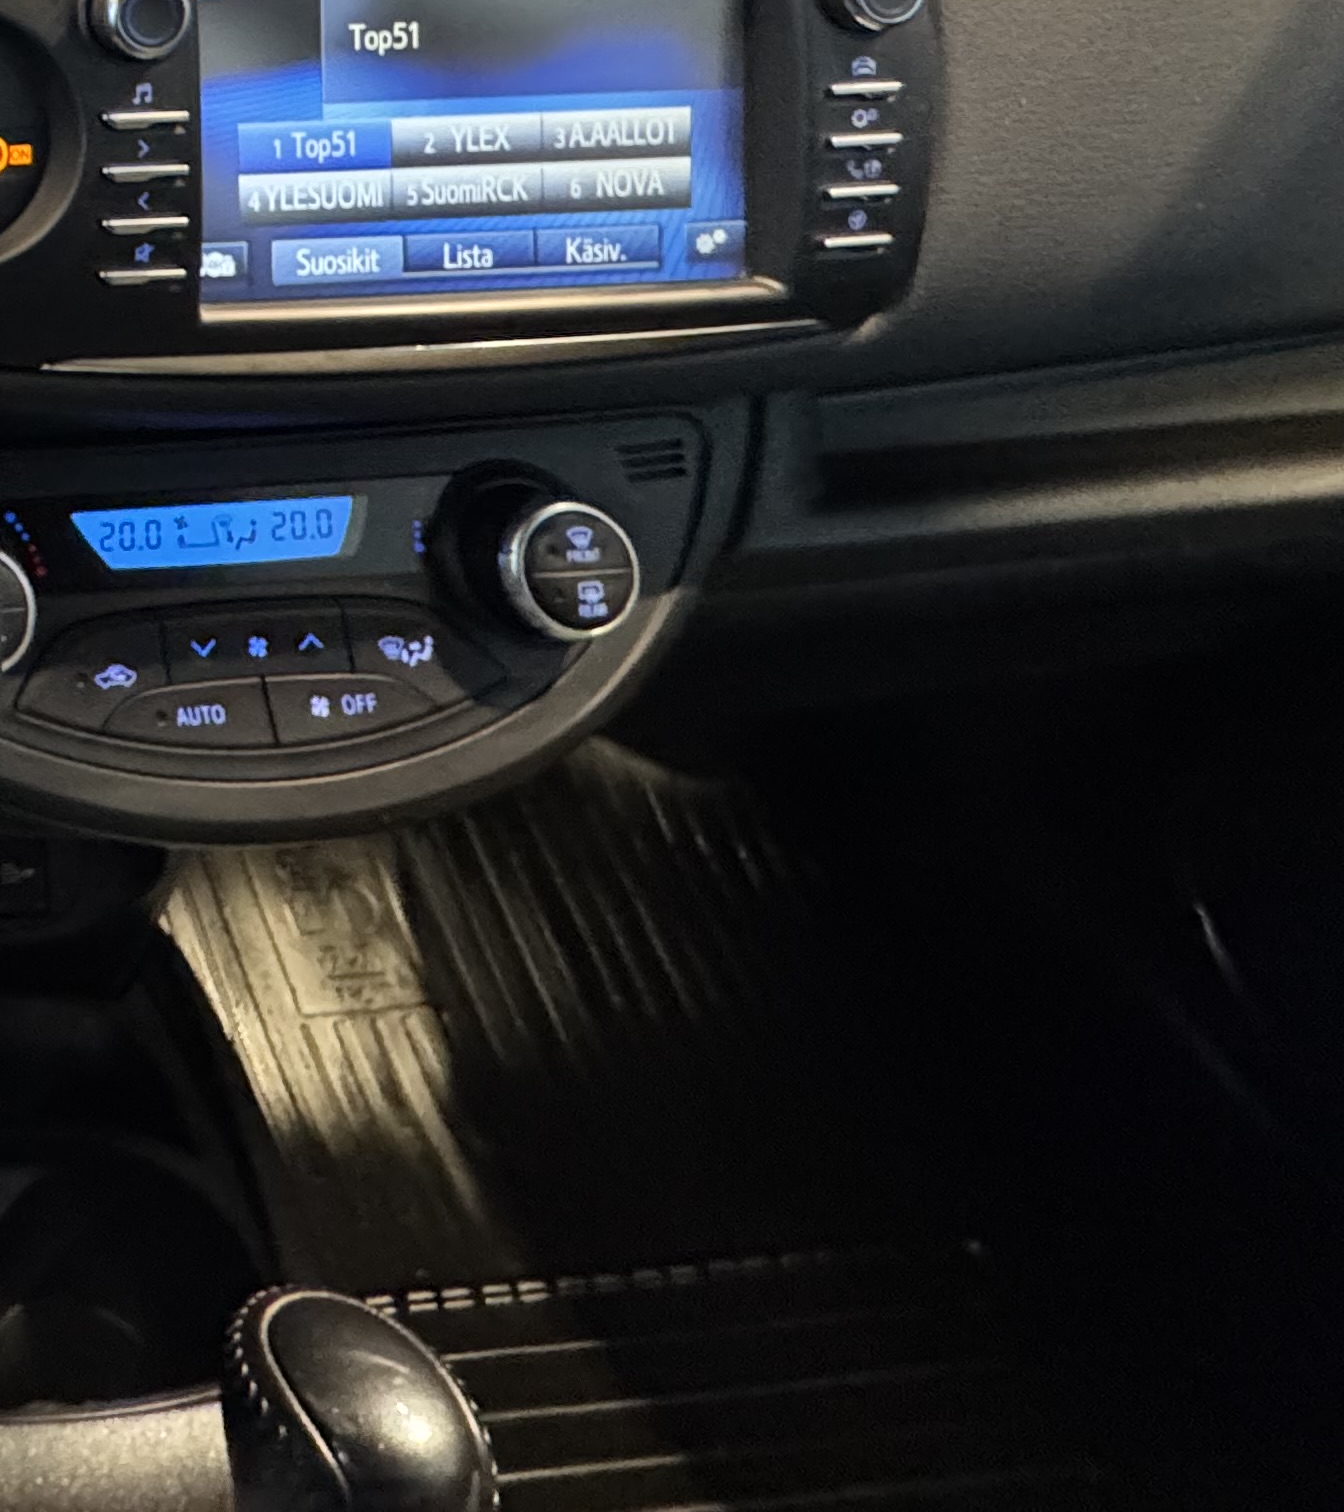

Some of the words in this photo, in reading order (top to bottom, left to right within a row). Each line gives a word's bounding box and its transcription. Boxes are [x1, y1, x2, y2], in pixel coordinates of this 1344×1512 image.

[348, 21, 420, 56] Top51
[273, 139, 282, 159] 1
[290, 129, 356, 164] Top51
[424, 132, 436, 154] 2
[450, 124, 512, 154] YLEX
[553, 127, 566, 149] 3
[247, 191, 261, 212] 4
[264, 180, 384, 212] YLESUOMI
[407, 186, 418, 206] 5
[570, 178, 581, 199] 6
[596, 170, 664, 199] NOVA
[296, 246, 380, 278] Suosikit
[443, 242, 494, 270] Lista
[565, 235, 627, 264] Käsiv.
[100, 520, 162, 552] 20.0
[272, 509, 333, 543] 20.0
[177, 704, 226, 727] AUTO
[341, 693, 378, 716] OFF
